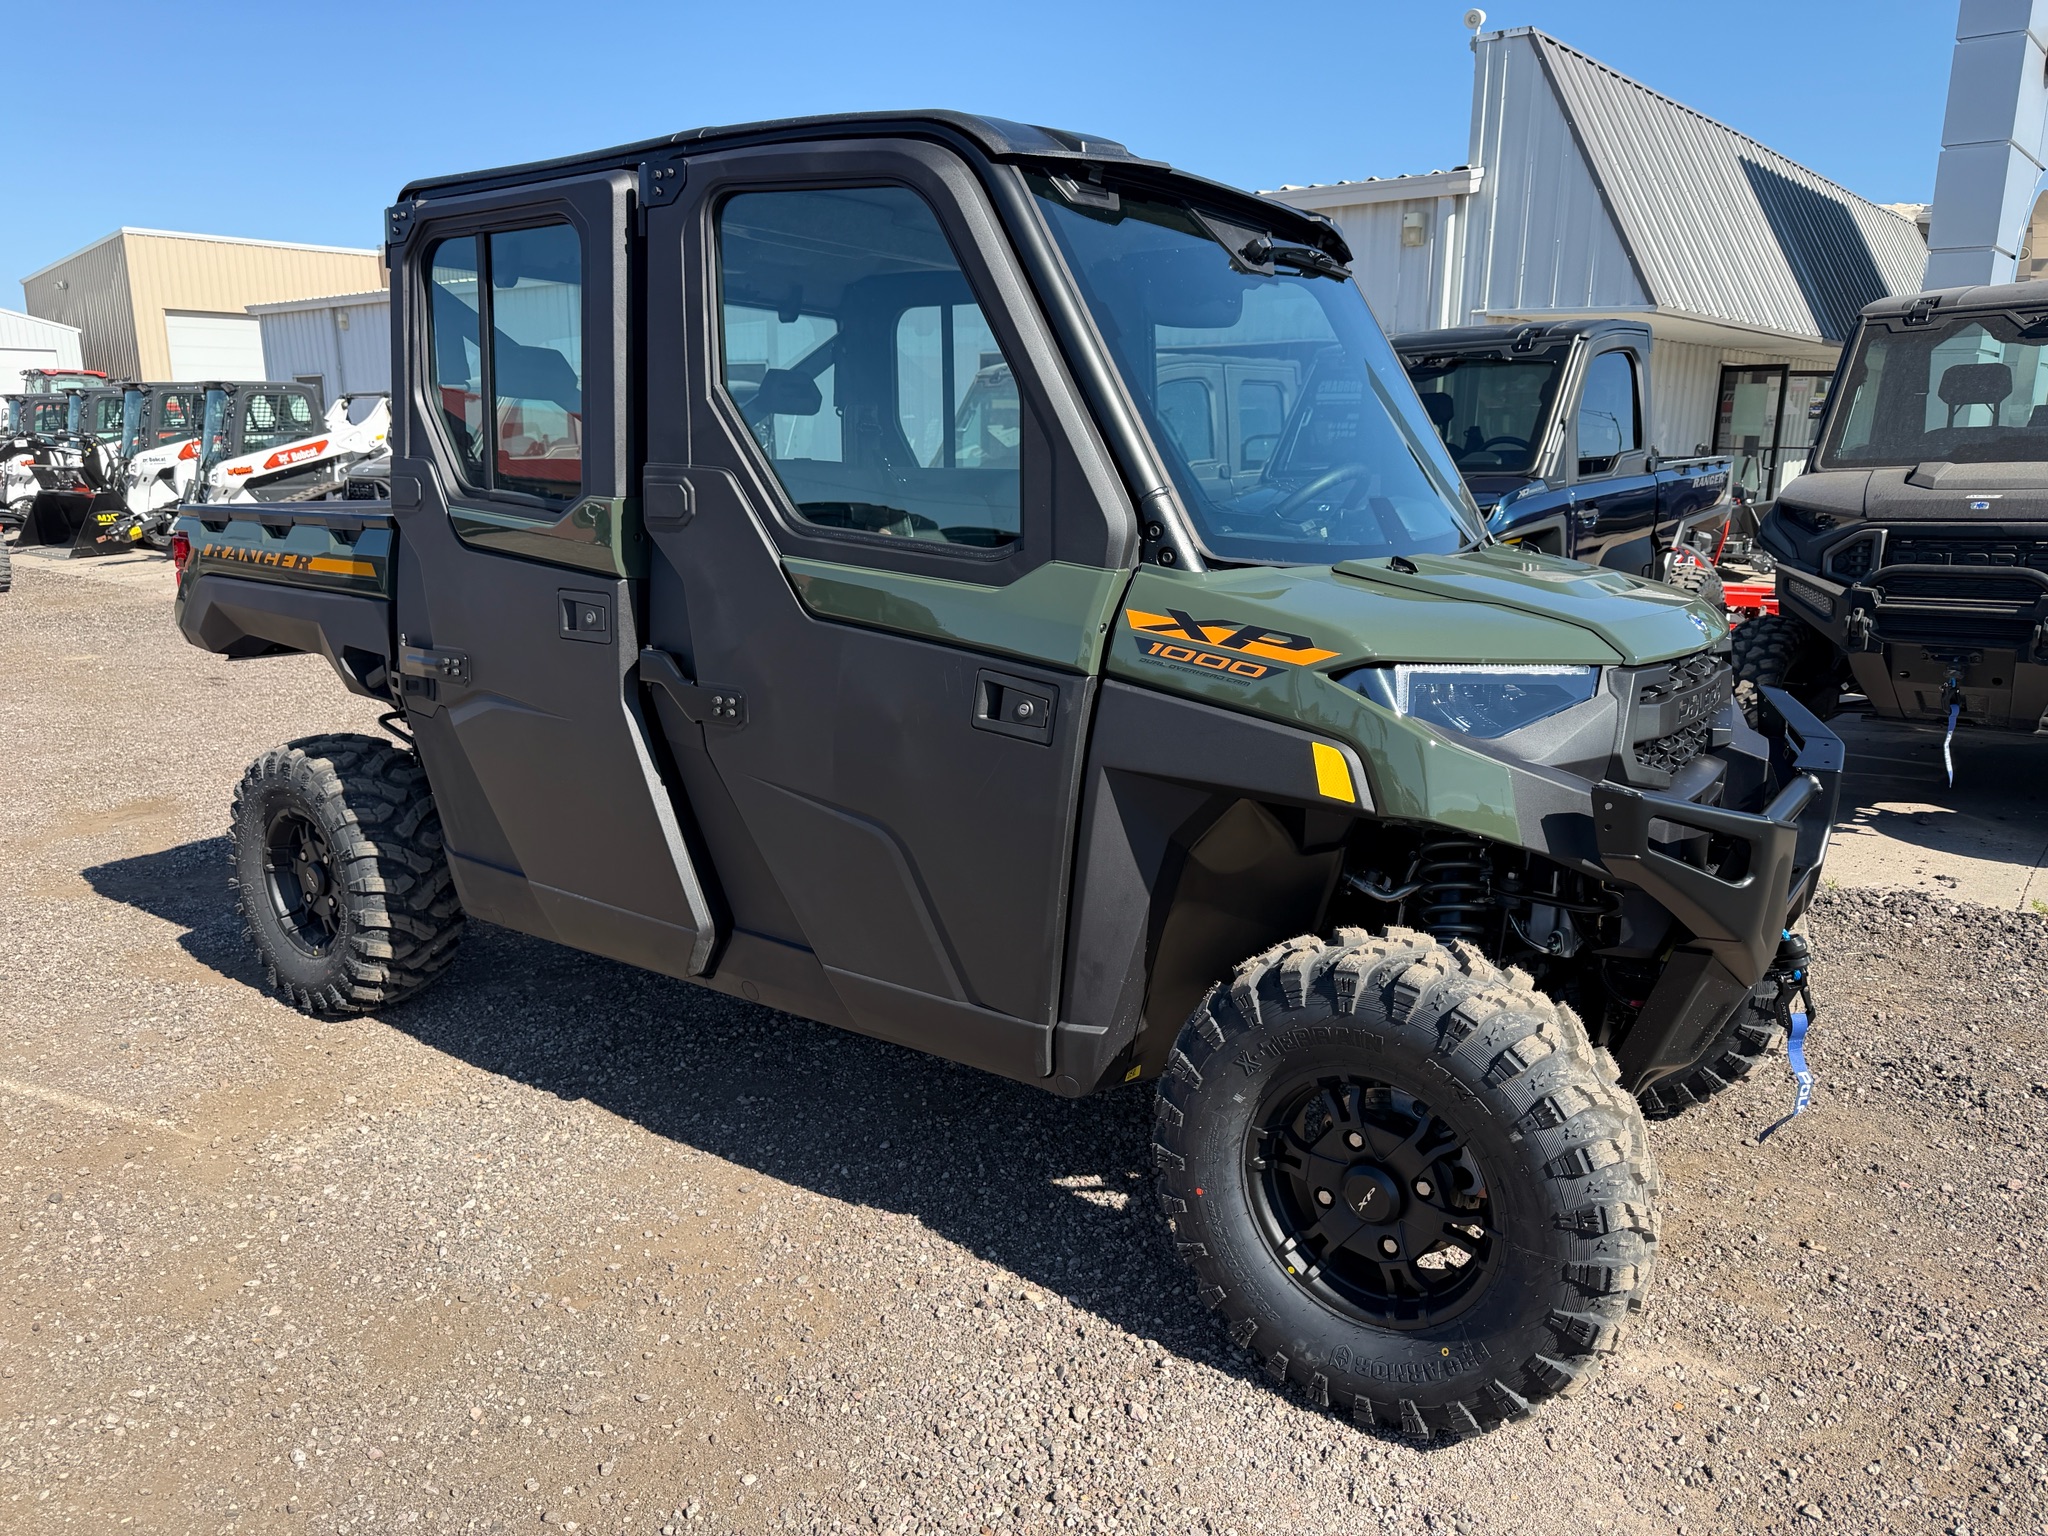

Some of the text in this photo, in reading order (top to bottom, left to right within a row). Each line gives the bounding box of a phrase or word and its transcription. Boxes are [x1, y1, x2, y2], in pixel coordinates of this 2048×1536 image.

[1692, 474, 1725, 489] RANGER
[204, 543, 313, 572] RANGER
[1136, 607, 1316, 652] XP
[1138, 656, 1252, 688] DUAL OVERHEAD CAM
[1147, 642, 1268, 678] 1000
[1232, 1026, 1386, 1078] X-TERRAIN
[1357, 1187, 1376, 1212] XP
